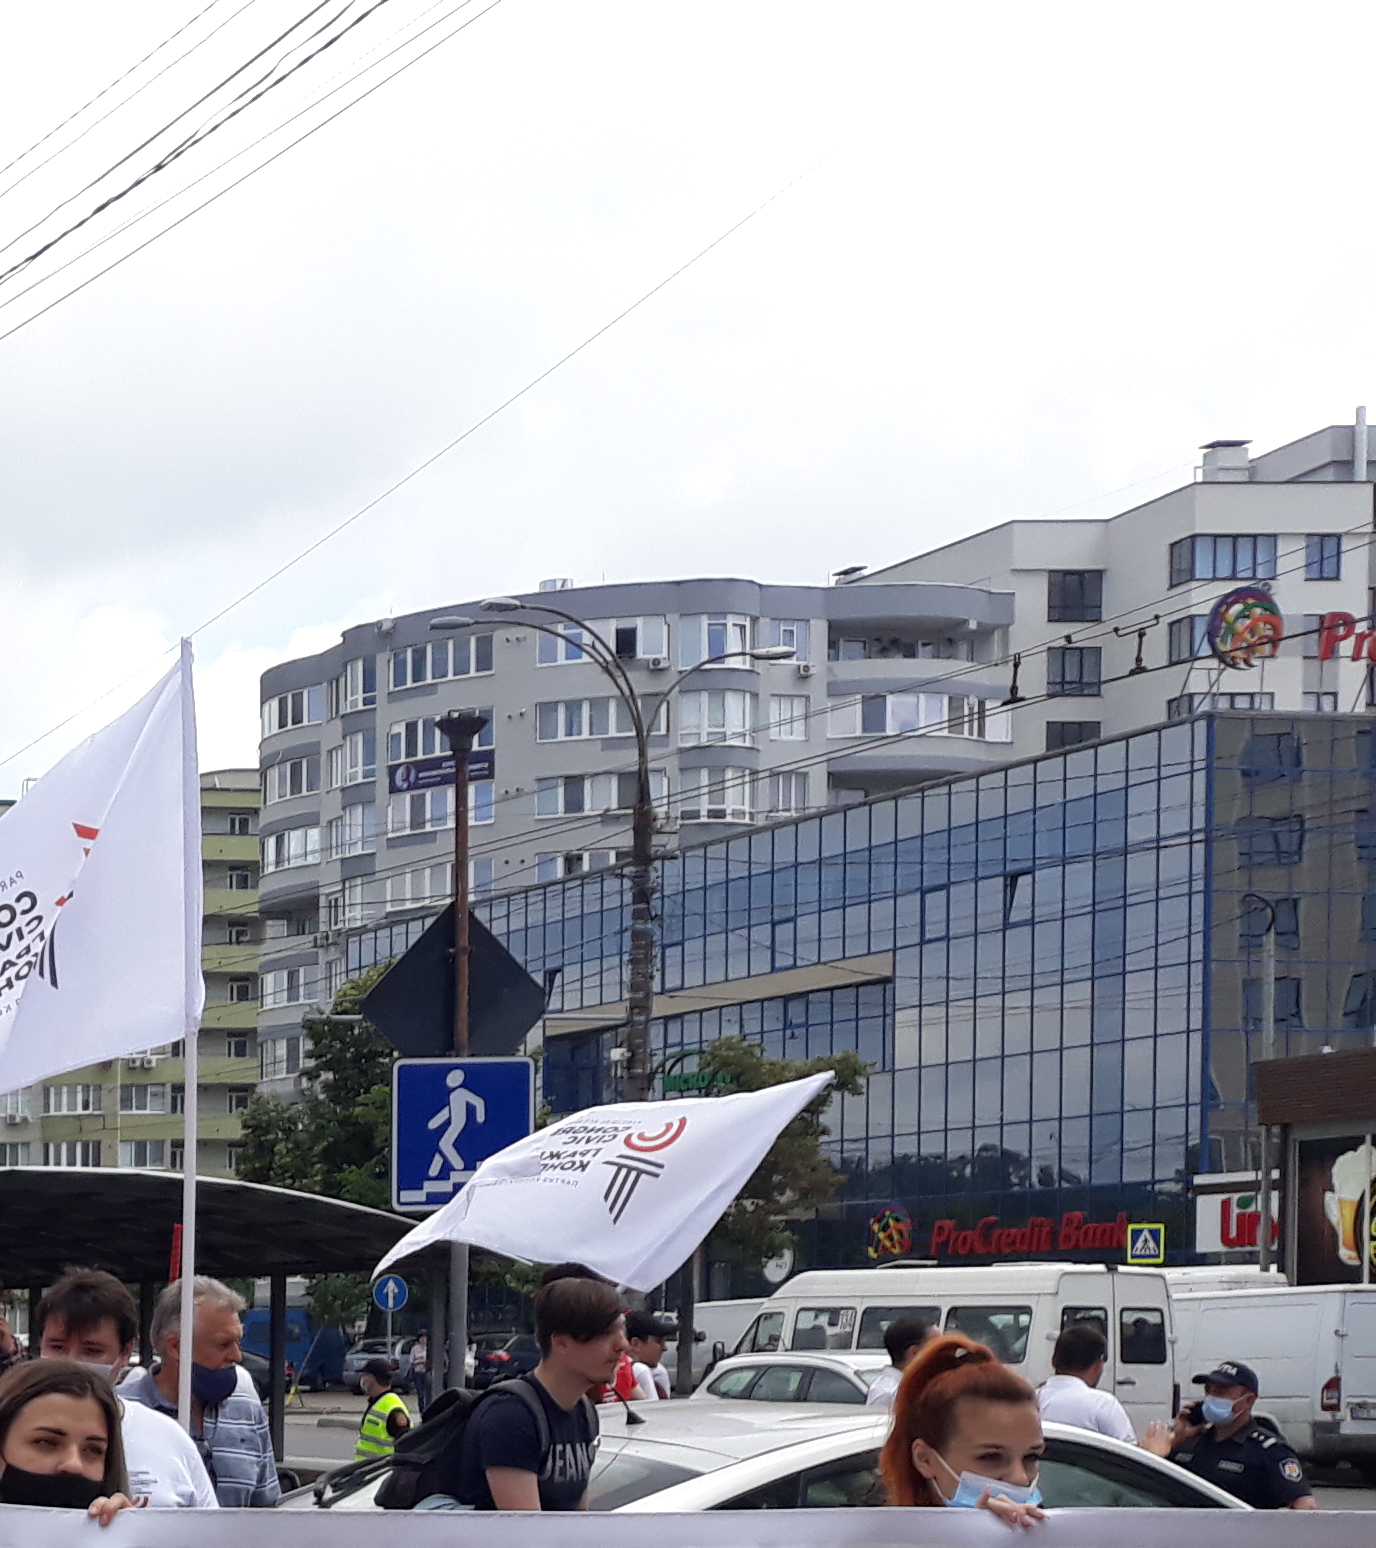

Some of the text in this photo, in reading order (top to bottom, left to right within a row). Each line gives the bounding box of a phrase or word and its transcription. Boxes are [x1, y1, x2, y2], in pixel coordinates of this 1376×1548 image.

[1318, 611, 1376, 662] Pr
[930, 1210, 1129, 1256] ProCredit Bank
